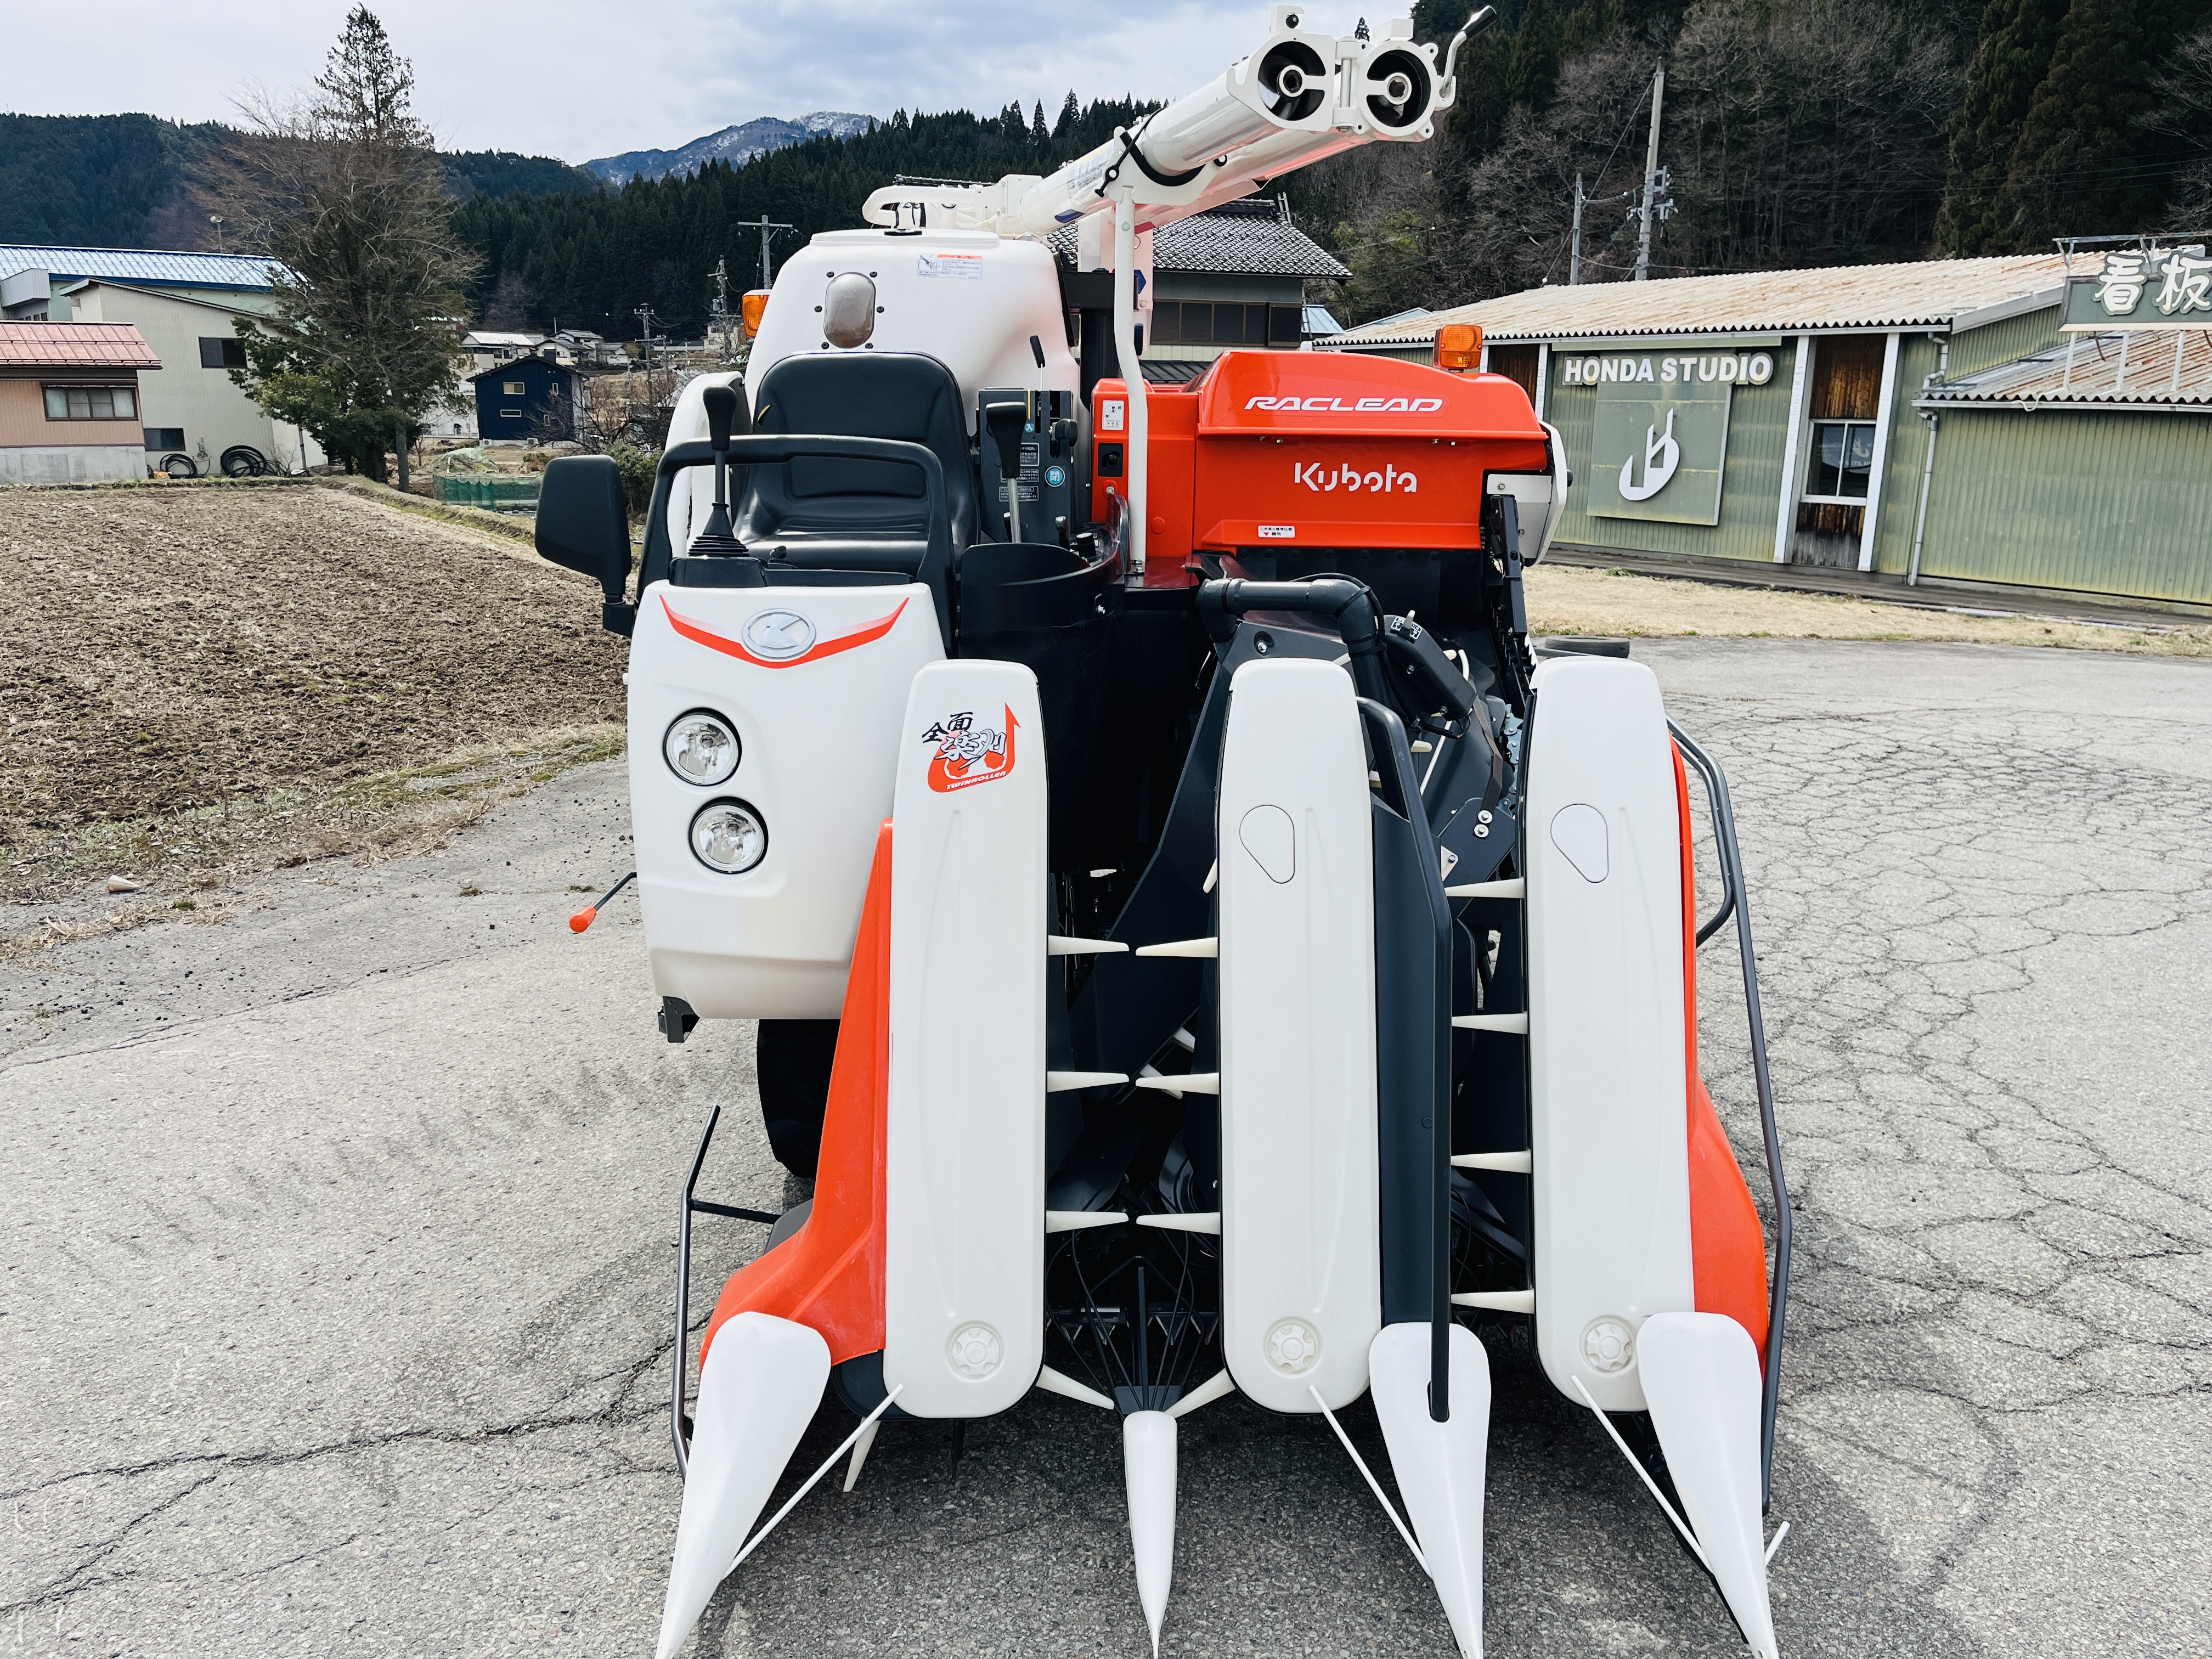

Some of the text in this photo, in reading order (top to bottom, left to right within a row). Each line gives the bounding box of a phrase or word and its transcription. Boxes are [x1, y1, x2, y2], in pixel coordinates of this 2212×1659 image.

[2094, 253, 2212, 311] 看板
[1564, 355, 1773, 383] HONDA STUDIO
[1244, 396, 1444, 413] RACLEAD
[1026, 423, 1033, 431] 入
[1049, 471, 1060, 482] 閉
[1294, 462, 1418, 493] Kubota
[922, 712, 974, 743] 全面
[946, 770, 1007, 790] TWINROLLER
